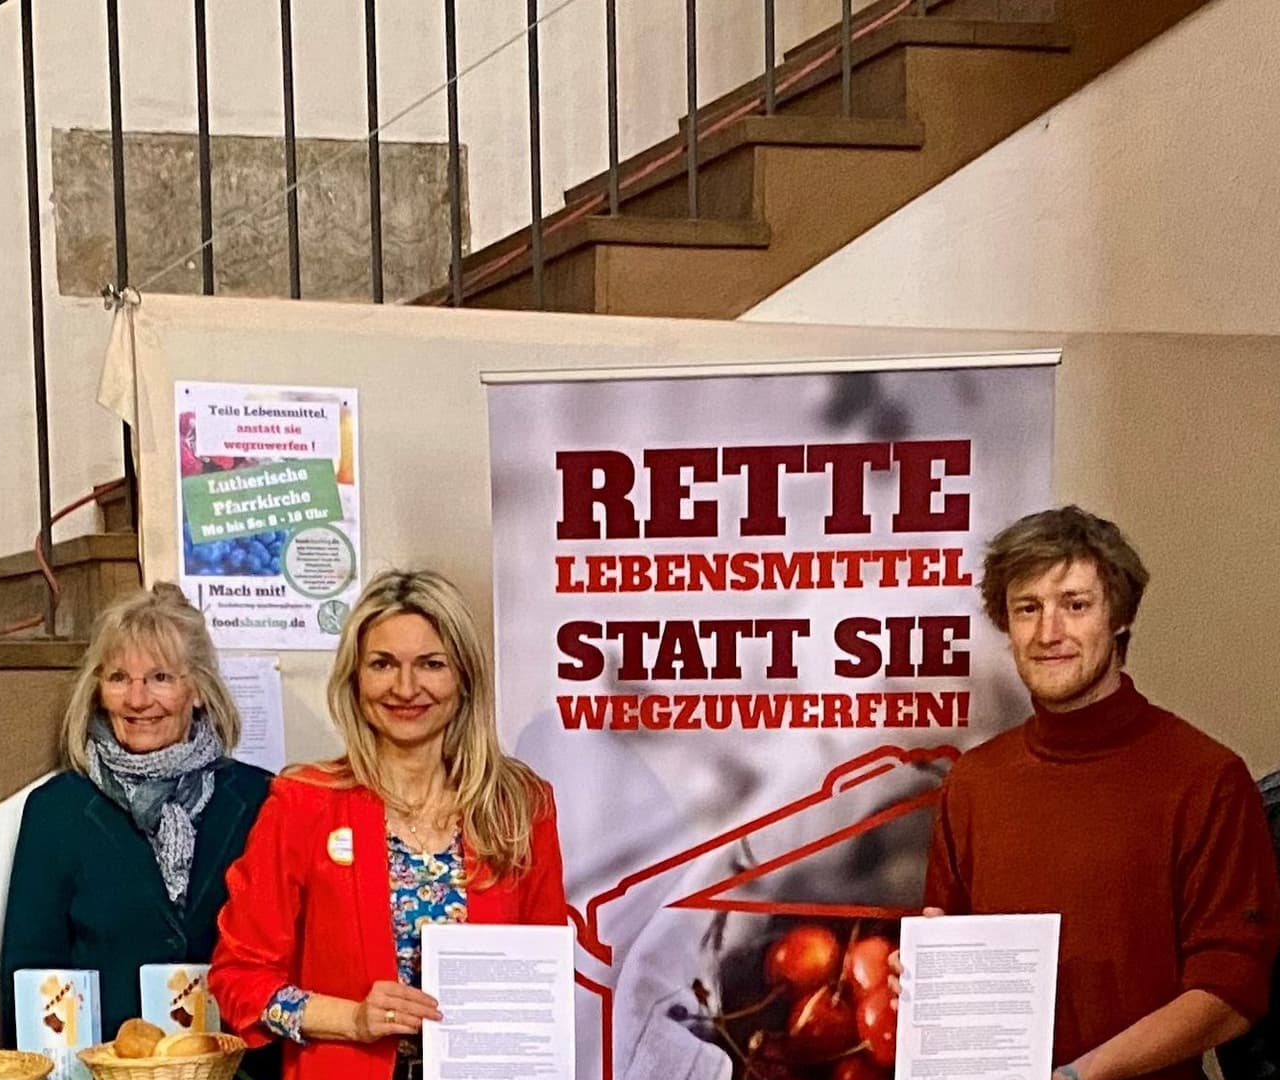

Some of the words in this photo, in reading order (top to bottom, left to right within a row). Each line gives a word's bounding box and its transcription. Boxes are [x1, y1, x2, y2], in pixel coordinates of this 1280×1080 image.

[208, 405, 240, 416] Teile
[237, 424, 281, 434] anstatt
[284, 424, 302, 435] sie
[207, 467, 309, 494] Lutherische
[555, 439, 971, 540] RETTE
[211, 489, 312, 517] Pfarrkirche
[201, 523, 224, 538] Mo
[226, 520, 246, 533] bis
[305, 508, 329, 520] Uhr
[555, 548, 972, 594] LEBENSMITTEL
[208, 584, 251, 597] Mach
[255, 585, 286, 597] mit!
[556, 618, 810, 681] STATT
[834, 615, 970, 679] SIE
[556, 691, 970, 731] WEGZUWERFEN!
